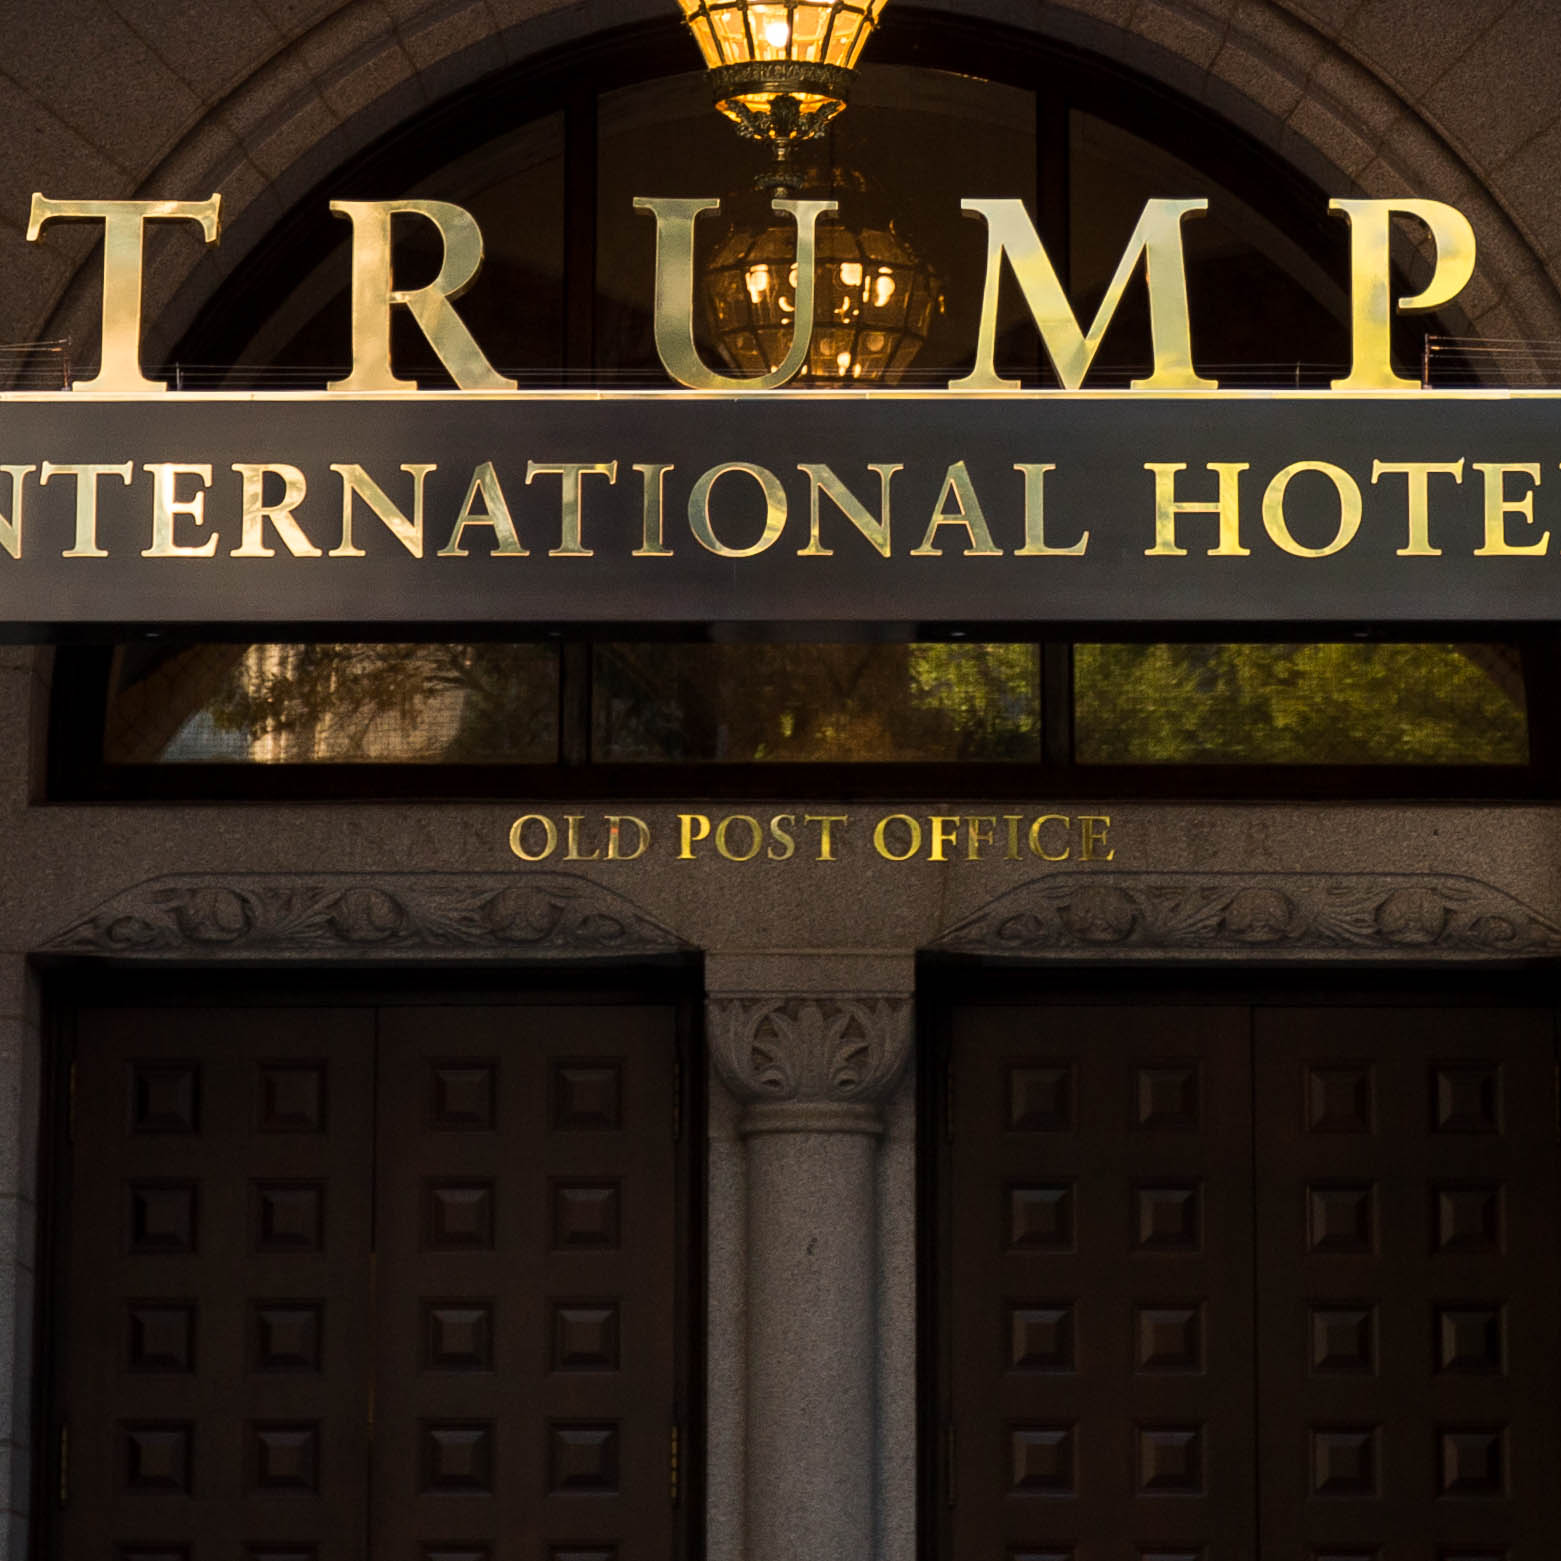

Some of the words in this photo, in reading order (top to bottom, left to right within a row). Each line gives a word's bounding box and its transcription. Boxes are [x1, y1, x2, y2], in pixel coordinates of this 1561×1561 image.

[26, 192, 1478, 393] TRUMP
[509, 813, 650, 862] OLD
[676, 813, 848, 862] POST
[873, 813, 1115, 862] OFFICE
